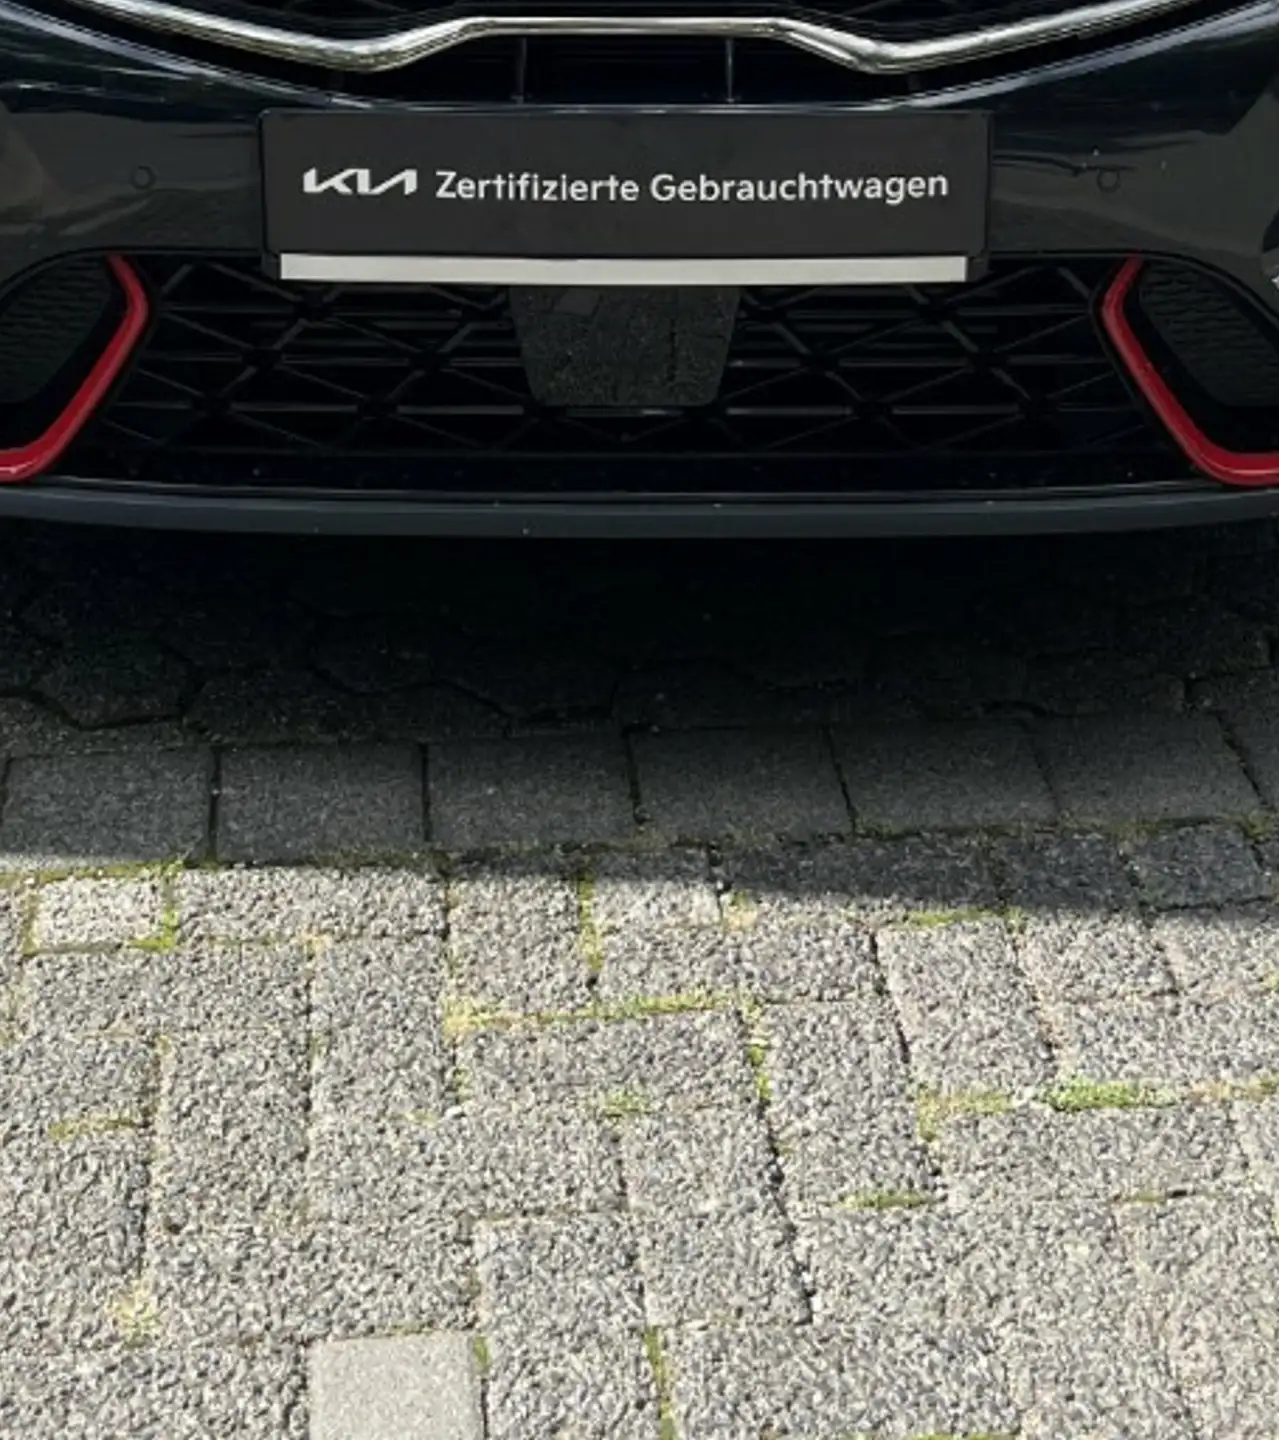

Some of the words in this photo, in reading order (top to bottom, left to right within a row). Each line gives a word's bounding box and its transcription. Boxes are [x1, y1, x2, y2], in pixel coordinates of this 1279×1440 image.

[302, 167, 418, 196] KIA
[434, 170, 641, 203] Zertifizierte
[650, 171, 949, 207] Gebrauchtwagen
